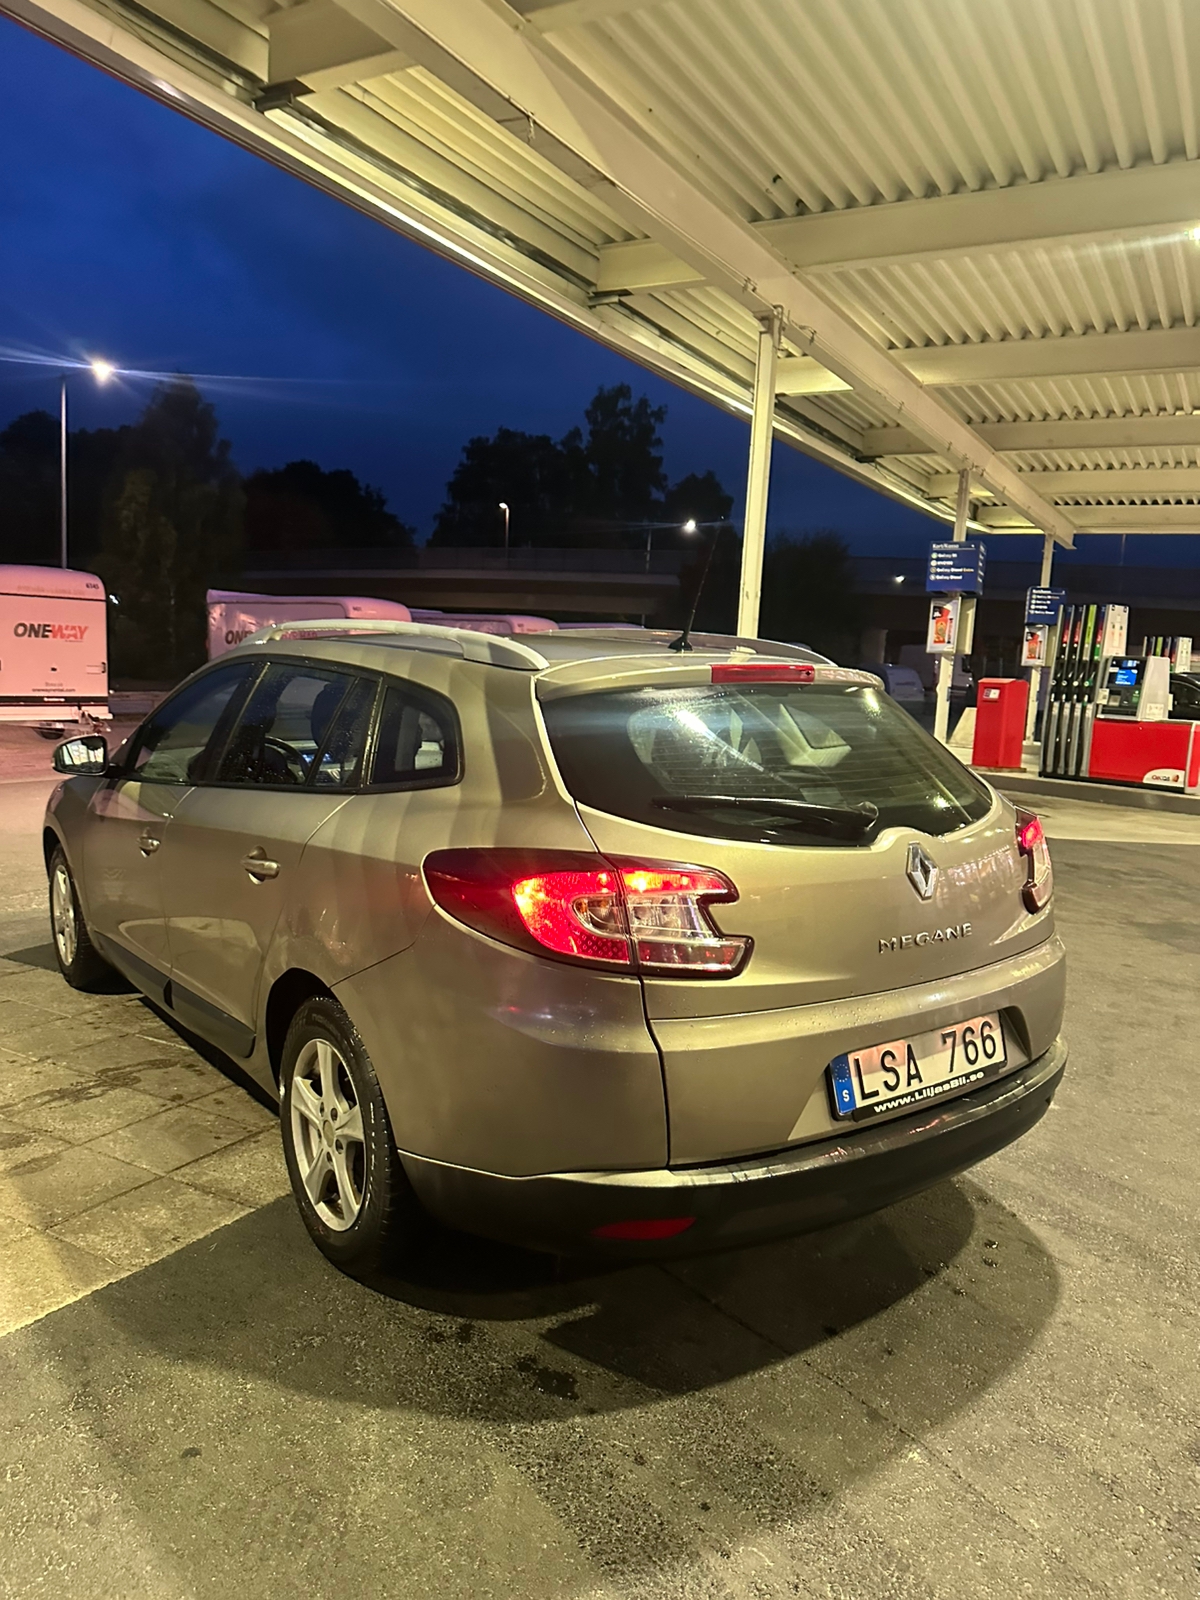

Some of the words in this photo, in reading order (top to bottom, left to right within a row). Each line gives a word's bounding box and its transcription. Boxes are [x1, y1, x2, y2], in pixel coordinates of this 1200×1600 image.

[878, 922, 973, 954] MEGANE
[853, 1043, 924, 1101] LSA
[940, 1020, 997, 1074] 766
[842, 1089, 850, 1102] S
